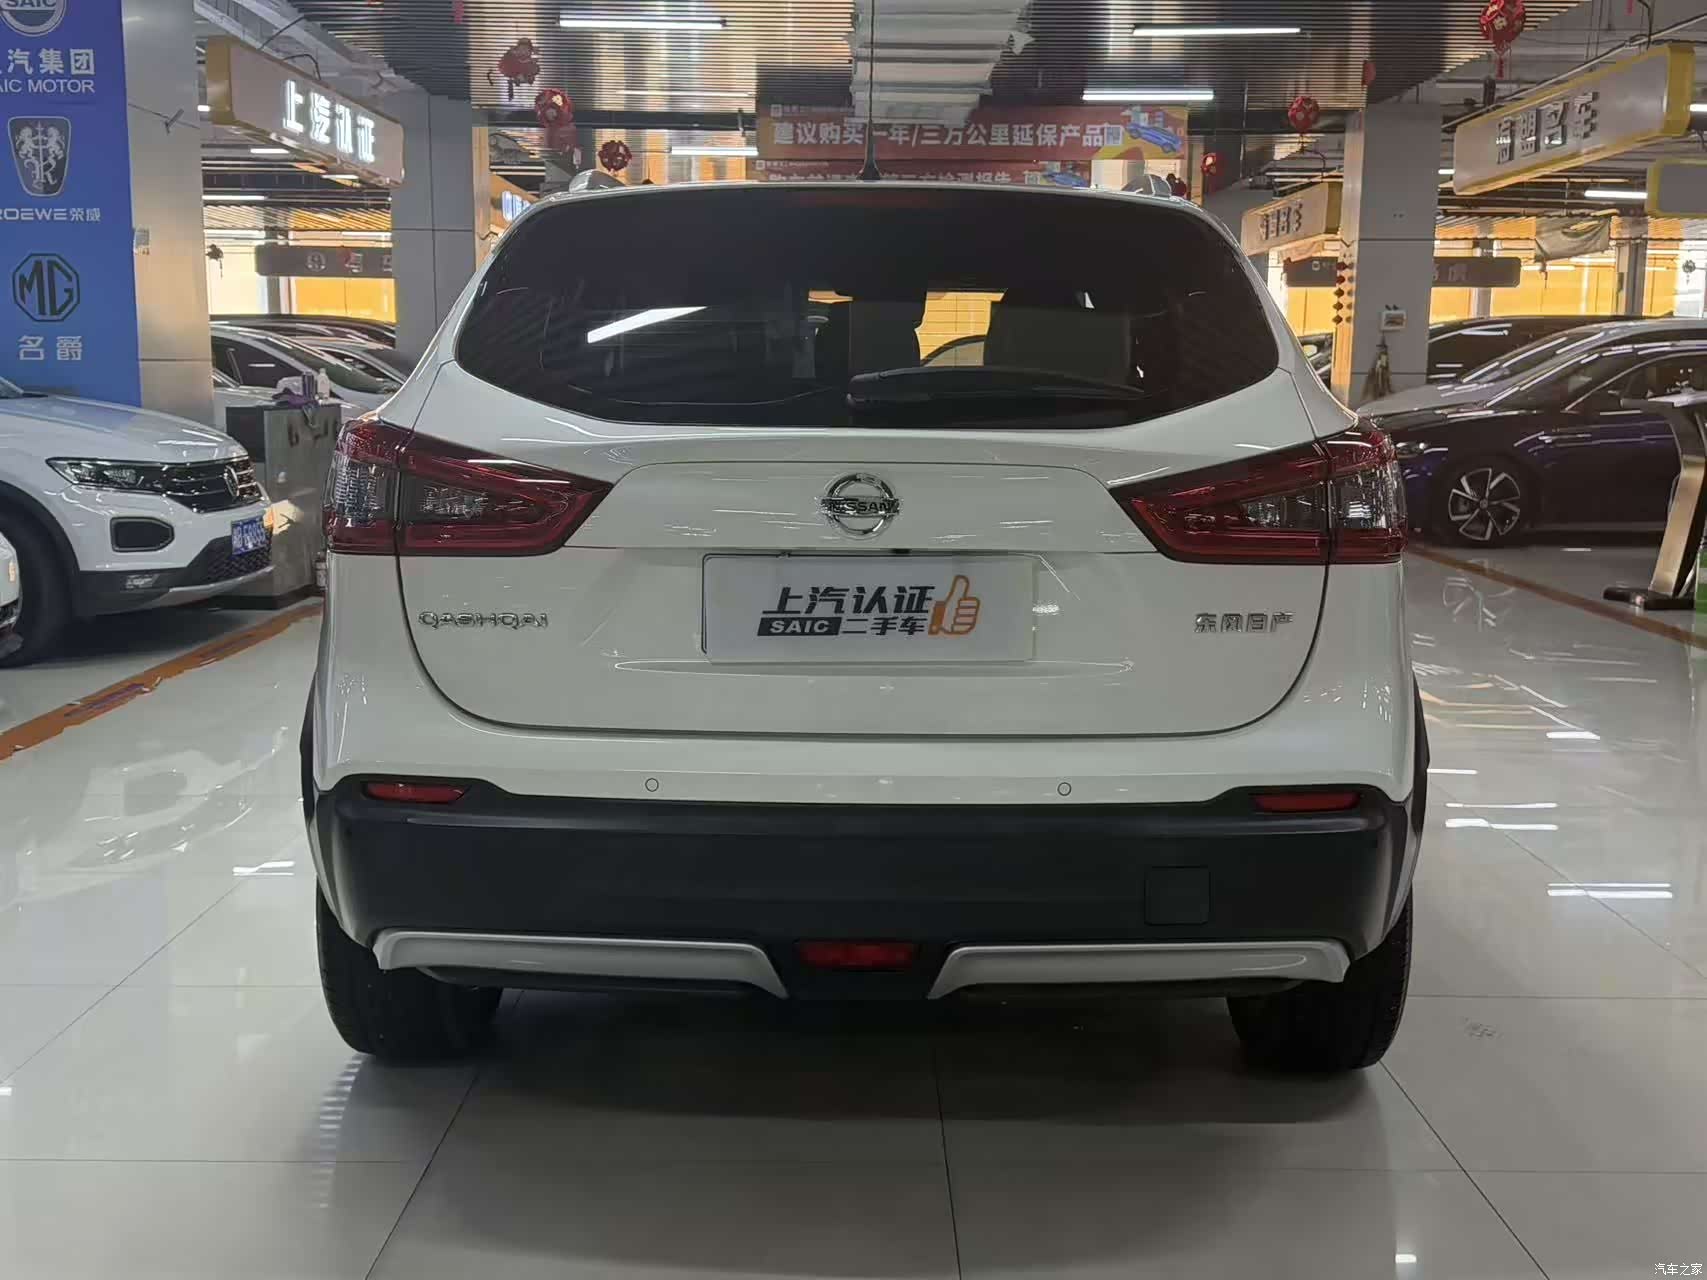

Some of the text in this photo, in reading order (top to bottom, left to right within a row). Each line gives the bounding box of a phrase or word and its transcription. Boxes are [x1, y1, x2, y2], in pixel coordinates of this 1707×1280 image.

[0, 48, 95, 75] 汽集团
[0, 79, 95, 93] IC MOTOR
[0, 208, 67, 221] OEWE
[18, 259, 74, 316] MG
[18, 335, 83, 361] 名爵
[762, 585, 936, 615] 上汽认证
[418, 611, 549, 630] QASHQAI
[769, 616, 926, 636] SAIC 二手车
[1194, 611, 1294, 633] 东风日产
